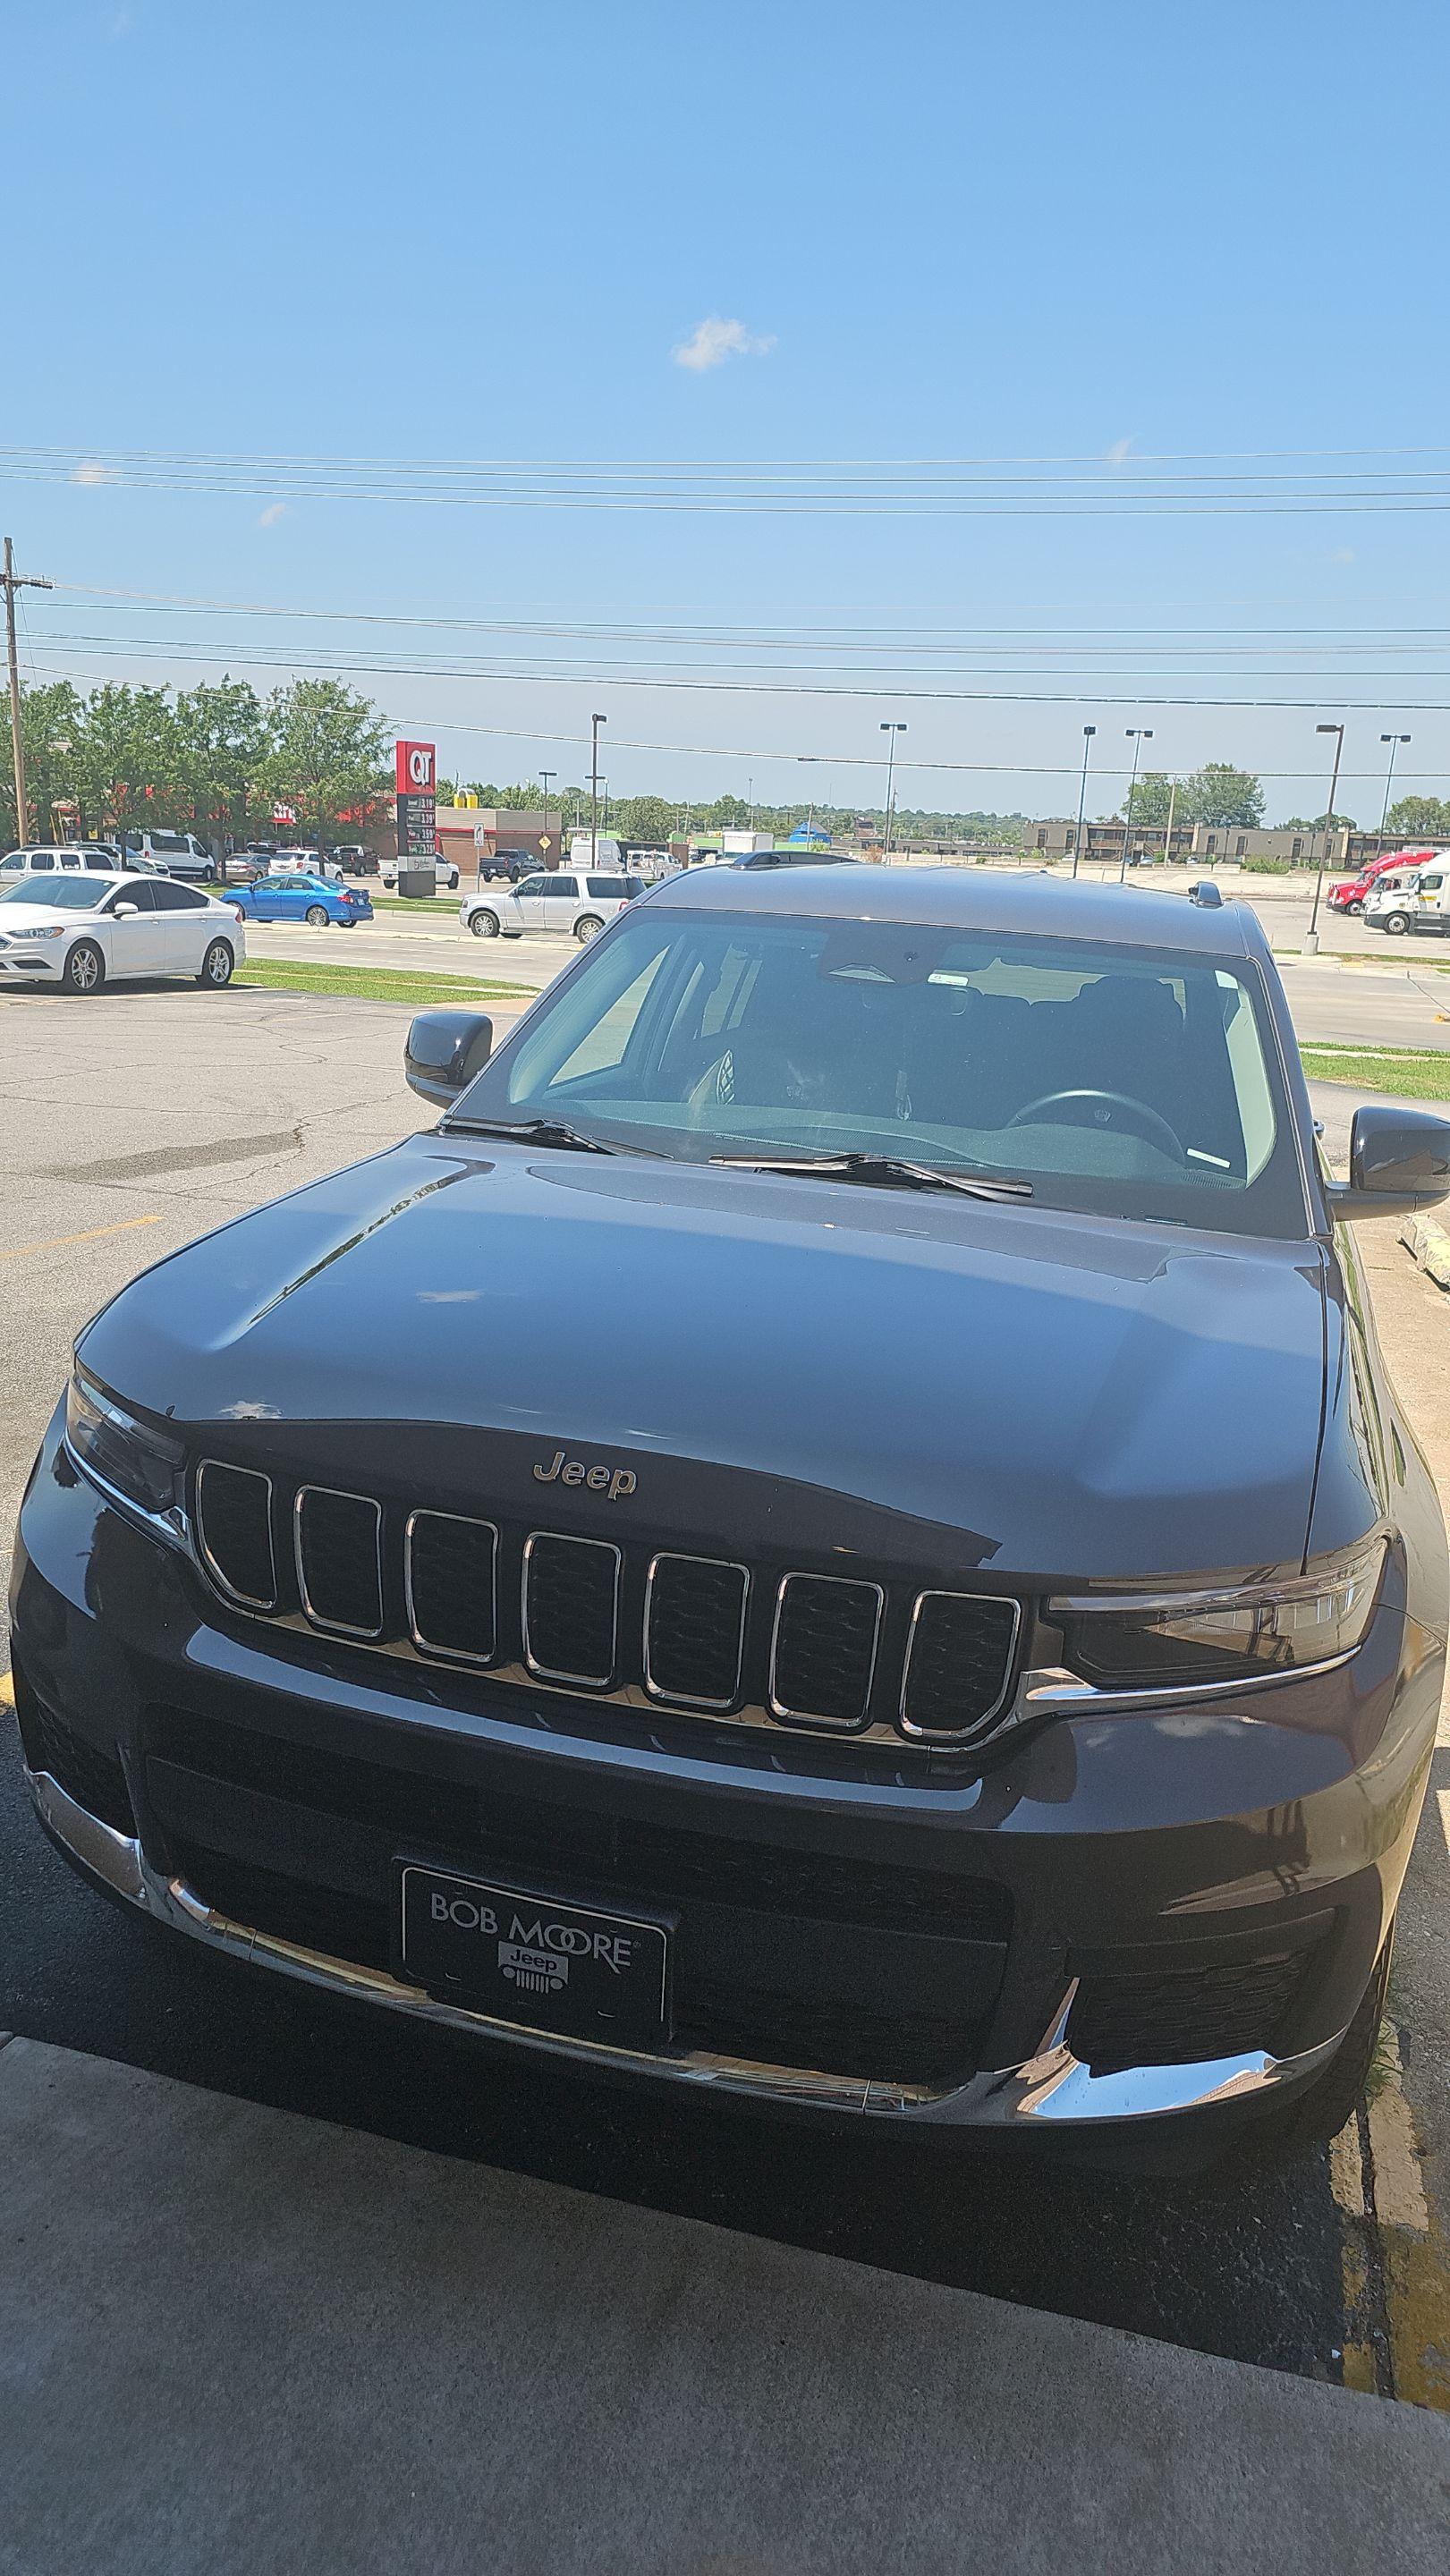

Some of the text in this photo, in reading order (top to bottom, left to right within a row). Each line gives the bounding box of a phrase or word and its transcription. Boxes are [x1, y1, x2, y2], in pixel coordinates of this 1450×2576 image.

[410, 750, 432, 786] QT
[533, 1452, 637, 1501] Jeep
[430, 1893, 632, 1975] BOB MOORE
[510, 1949, 556, 1972] Jeep
